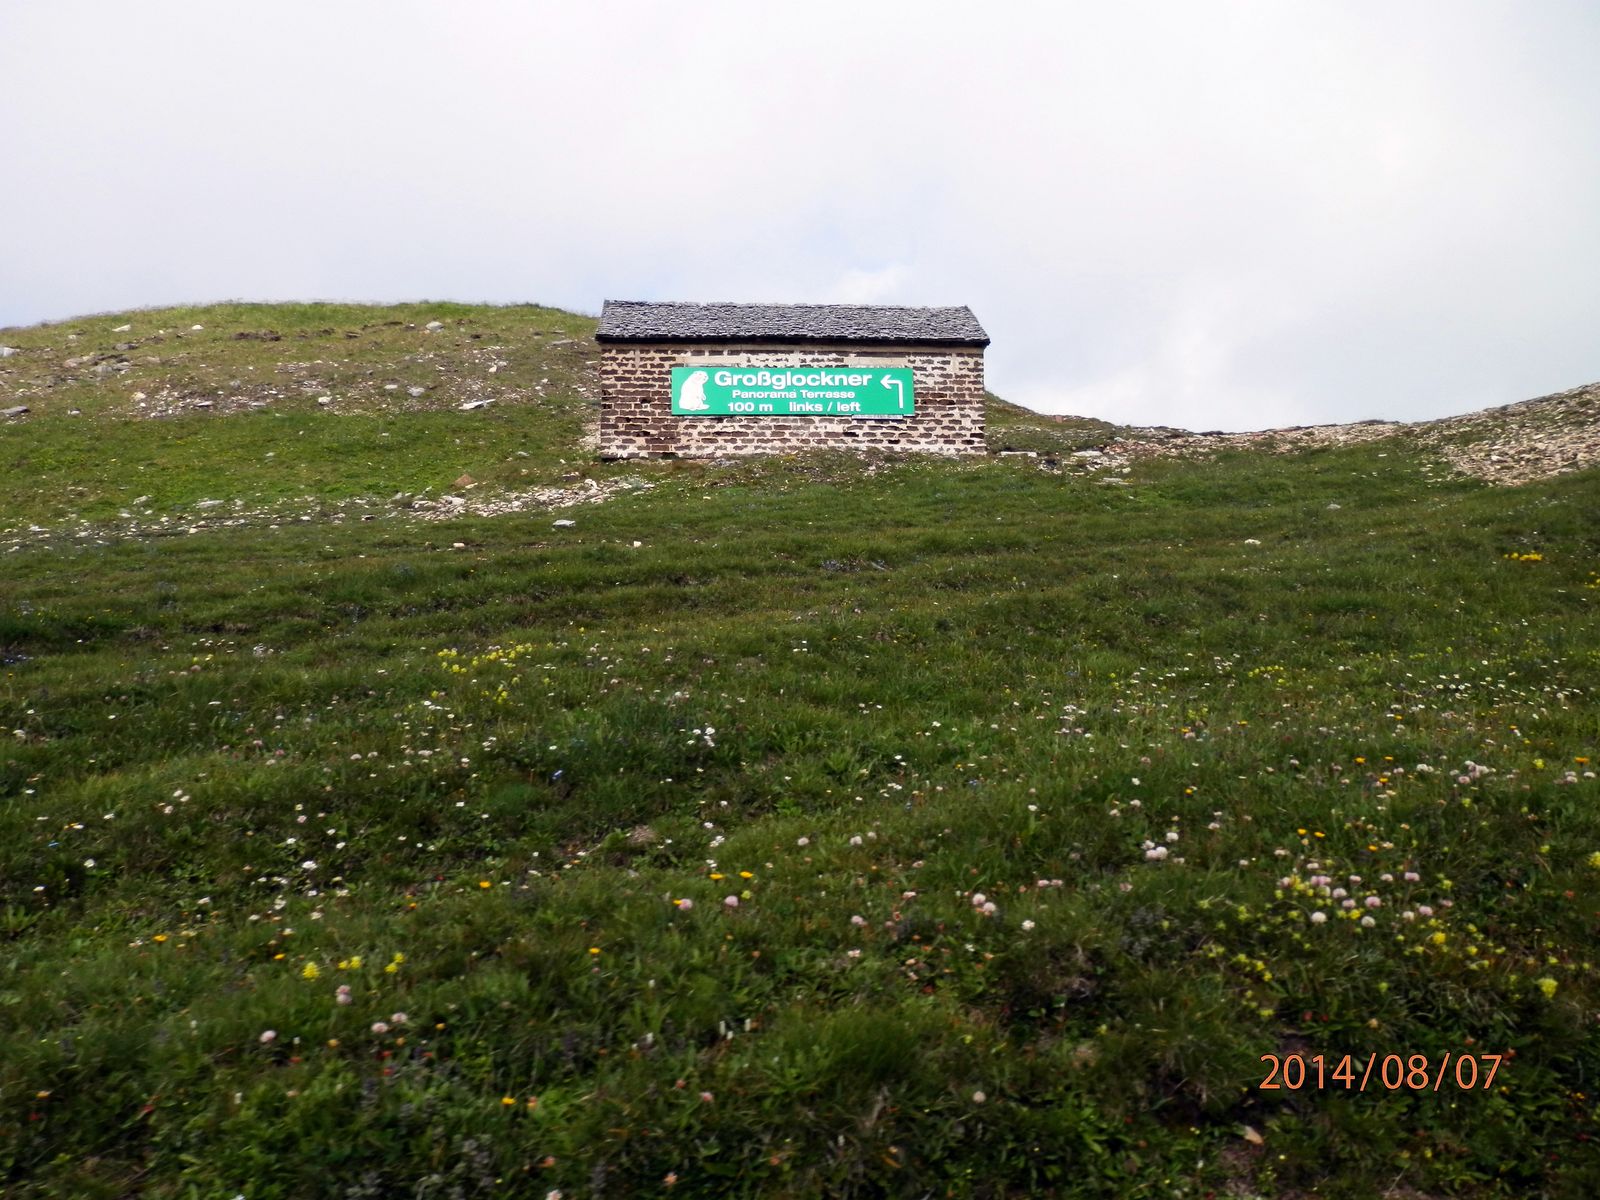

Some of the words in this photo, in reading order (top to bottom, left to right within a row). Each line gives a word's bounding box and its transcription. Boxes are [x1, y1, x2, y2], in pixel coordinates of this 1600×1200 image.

[714, 371, 872, 390] Großglockner
[732, 390, 797, 399] Panorama
[800, 390, 855, 399] Terrasse
[728, 402, 754, 412] 100
[759, 404, 773, 412] m
[789, 402, 823, 412] links
[826, 402, 833, 412] /
[837, 402, 861, 412] left
